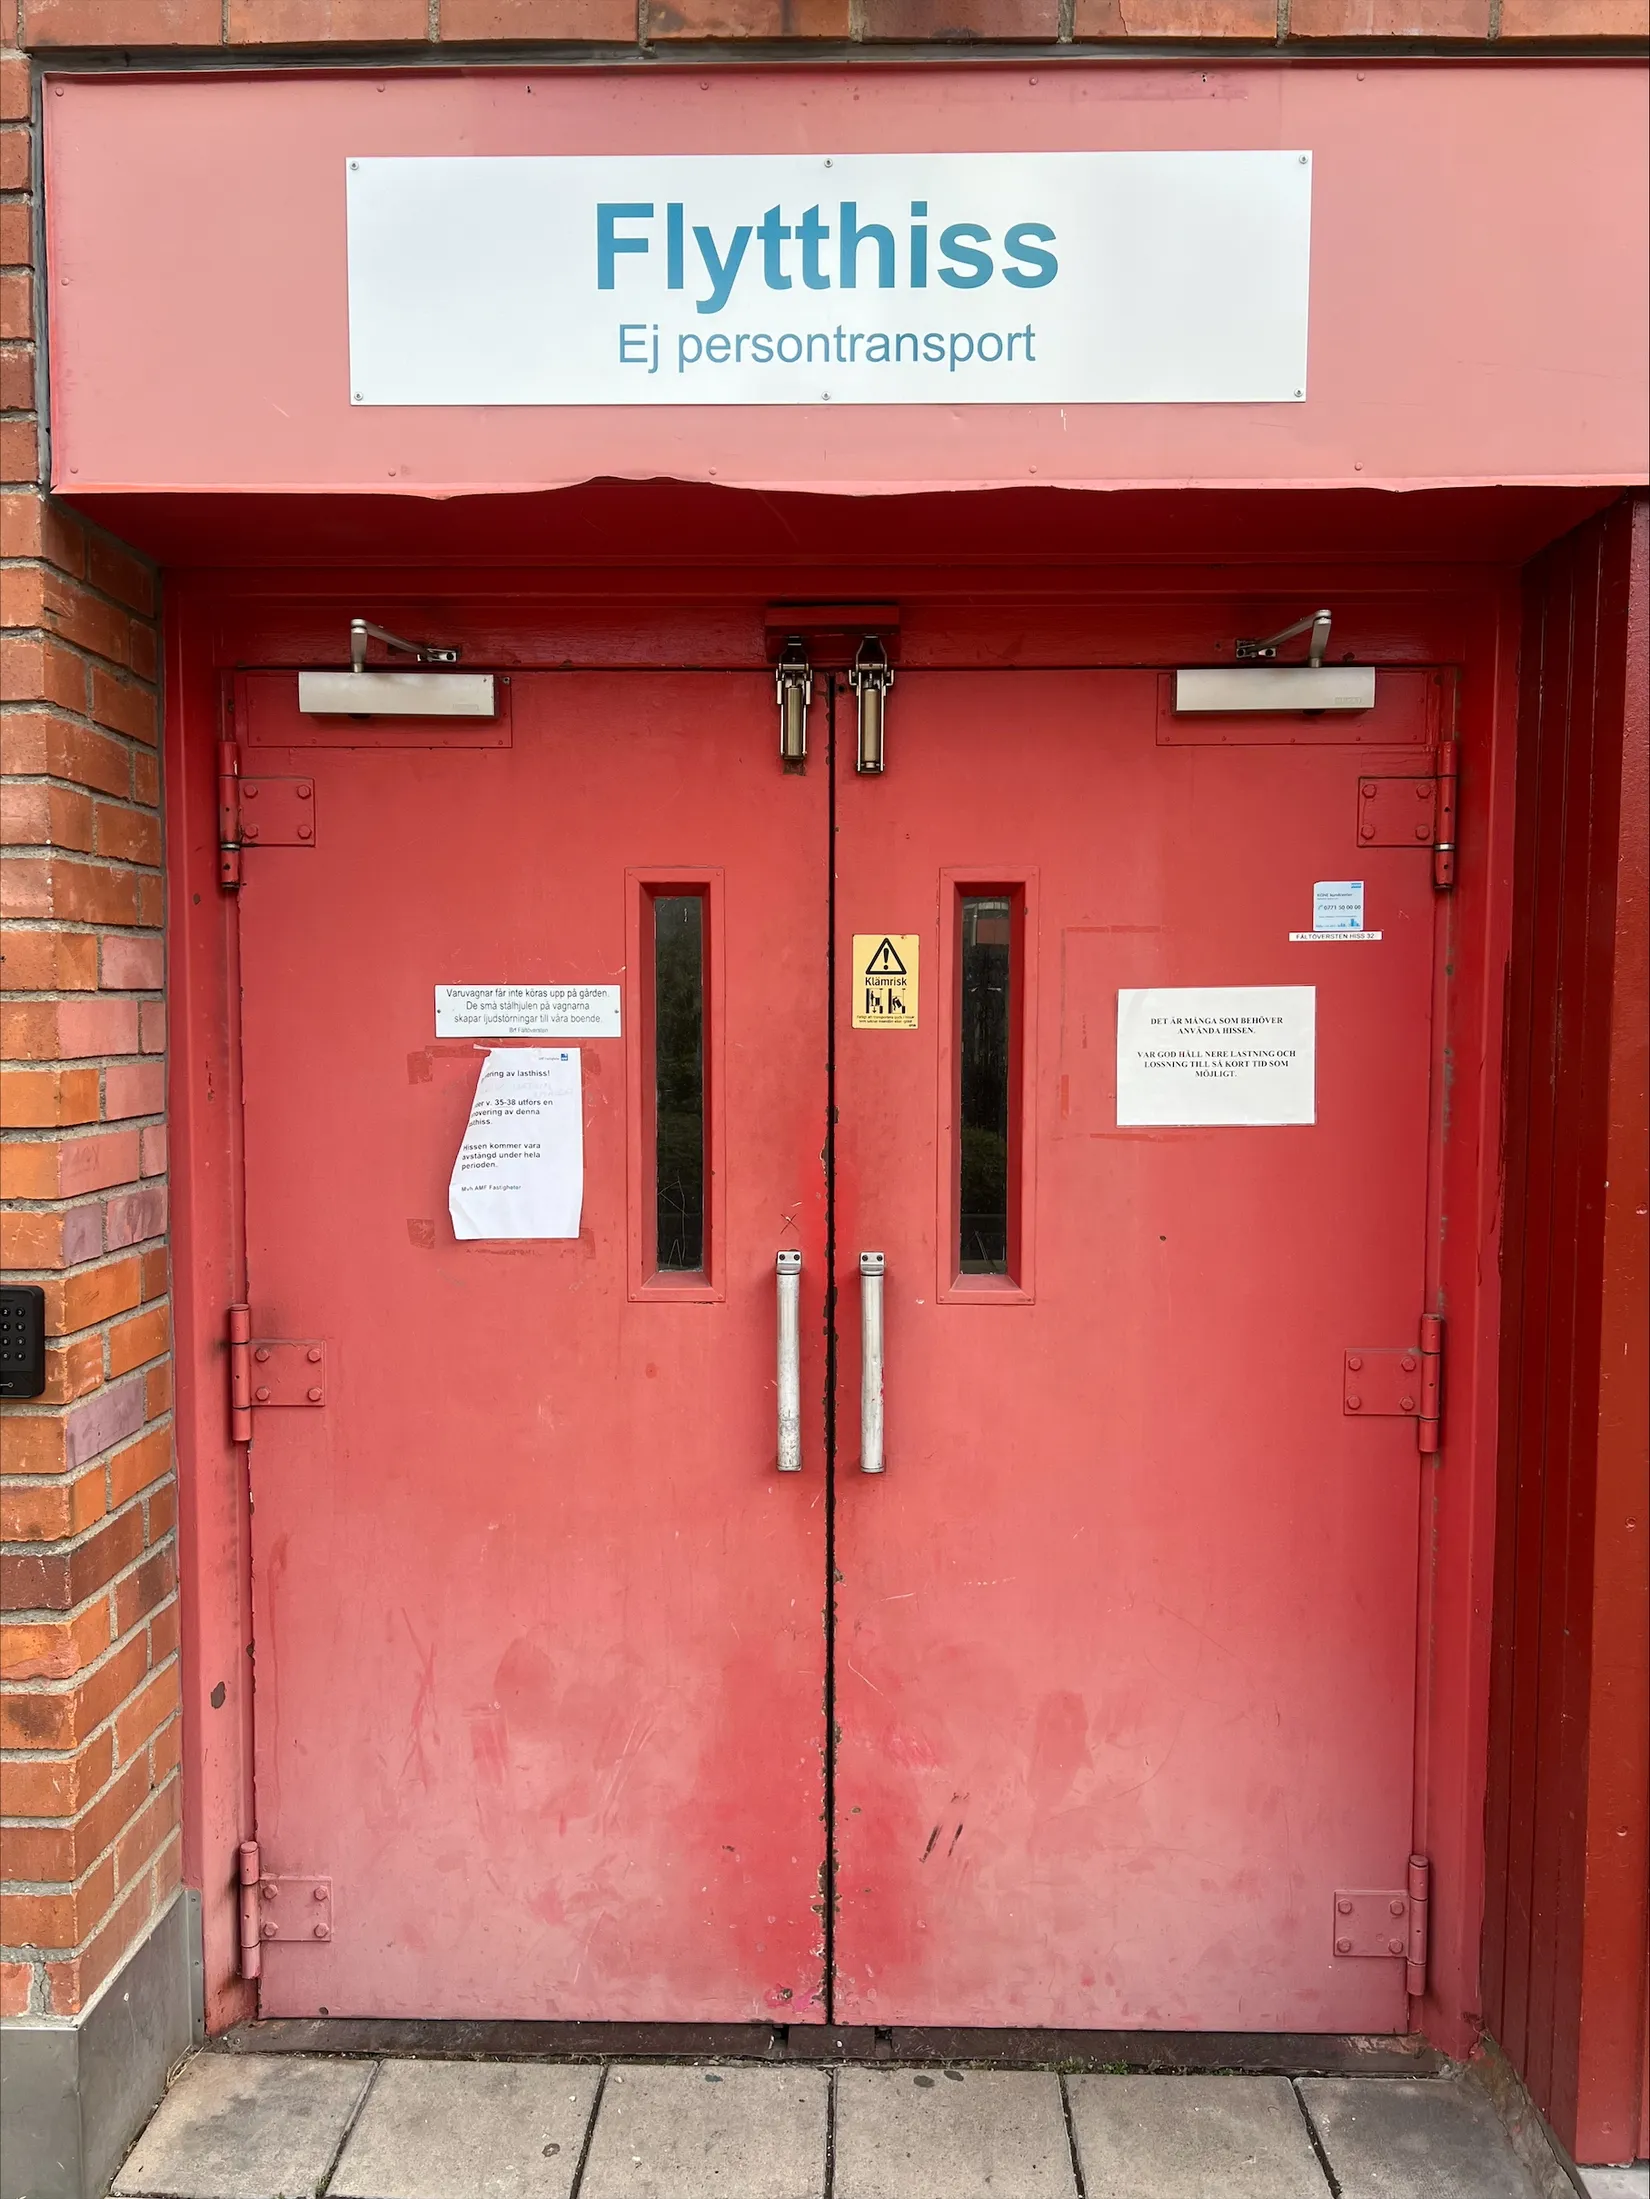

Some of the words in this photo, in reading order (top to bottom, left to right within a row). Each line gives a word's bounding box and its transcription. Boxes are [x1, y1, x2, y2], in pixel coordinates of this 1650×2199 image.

[596, 201, 1059, 313] Flytthiss
[619, 324, 659, 374] Ej
[677, 323, 1037, 374] persontransport
[865, 976, 907, 987] Klämrisk
[446, 988, 493, 1000] Varuvagnar
[494, 988, 507, 998] får
[508, 988, 523, 998] inte
[525, 988, 548, 998] köras
[549, 989, 565, 1000] upp
[567, 988, 577, 1000] på
[579, 988, 610, 1000] gården.
[466, 1001, 477, 1010] De
[480, 1000, 498, 1010] små
[499, 1000, 538, 1012] stålhjulen
[540, 1000, 550, 1012] på
[552, 1002, 590, 1013] vagnarna
[454, 1015, 481, 1025] skapar
[483, 1014, 538, 1026] ljudstörningar
[540, 1014, 549, 1023] till
[551, 1013, 568, 1023] våra
[570, 1014, 603, 1024] boende.
[1150, 1017, 1168, 1025] DET
[1169, 1016, 1183, 1025] ÄR
[1185, 1016, 1217, 1025] MÅNGA
[1219, 1017, 1239, 1025] SOM
[1240, 1015, 1284, 1025] BEHÖVER
[1177, 1026, 1221, 1035] ANVÄNDA
[1222, 1026, 1256, 1035] HISSEN.
[1137, 1050, 1156, 1059] VAR
[1157, 1050, 1177, 1058] GOD
[1178, 1049, 1203, 1058] HÅLL
[1204, 1050, 1229, 1058] NERE
[1230, 1050, 1275, 1058] LASTNING
[1276, 1050, 1297, 1058] OCH
[1144, 1060, 1188, 1068] LOSSNING
[1189, 1060, 1210, 1068] TILL
[1211, 1059, 1223, 1068] SÅ
[1224, 1060, 1250, 1068] KORT
[1252, 1060, 1268, 1068] TID
[1269, 1060, 1289, 1068] SOM
[517, 1069, 550, 1077] lasthiss!
[1195, 1069, 1237, 1078] MÖJLIGT.
[494, 1098, 517, 1106] 35-38
[463, 1143, 487, 1151] Hissen
[499, 1151, 522, 1159] under
[461, 1161, 498, 1171] perioden.
